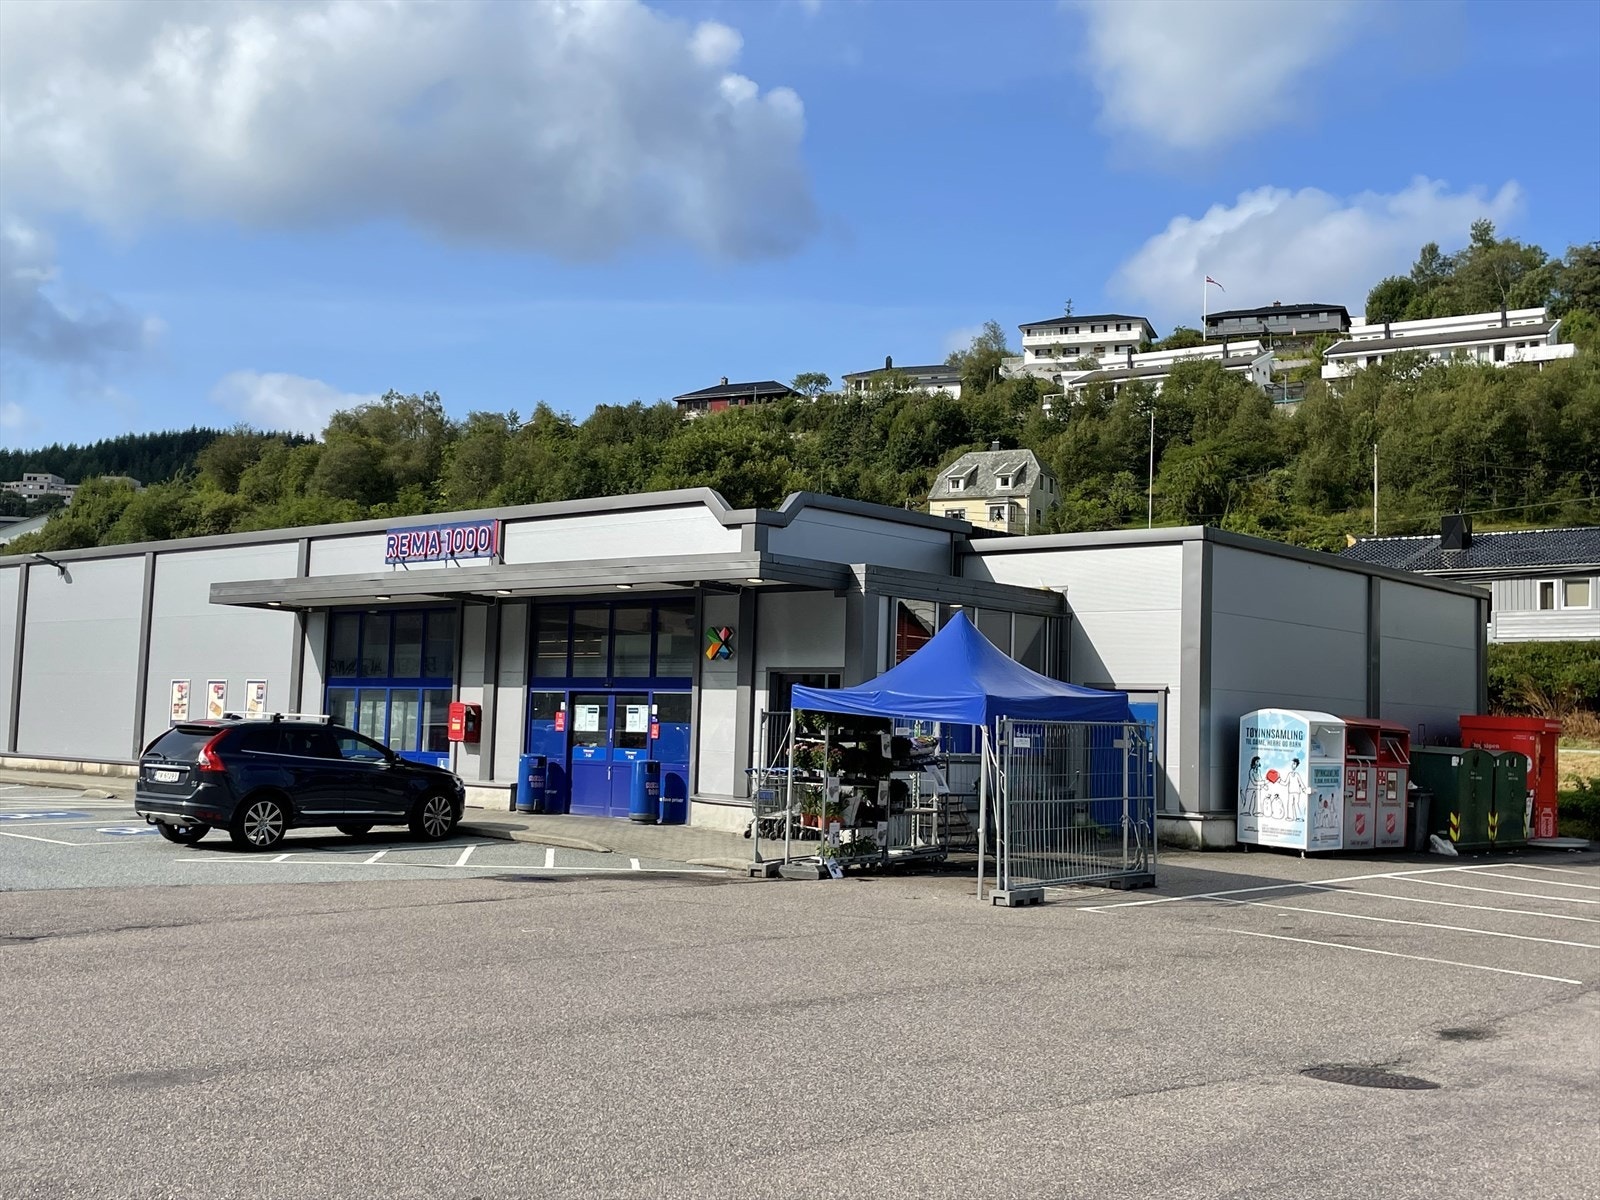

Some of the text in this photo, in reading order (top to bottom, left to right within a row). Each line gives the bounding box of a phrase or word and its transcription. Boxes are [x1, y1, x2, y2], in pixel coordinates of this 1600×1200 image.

[386, 526, 491, 558] REMA 1000
[1246, 727, 1304, 741] TØYINNSAMLING
